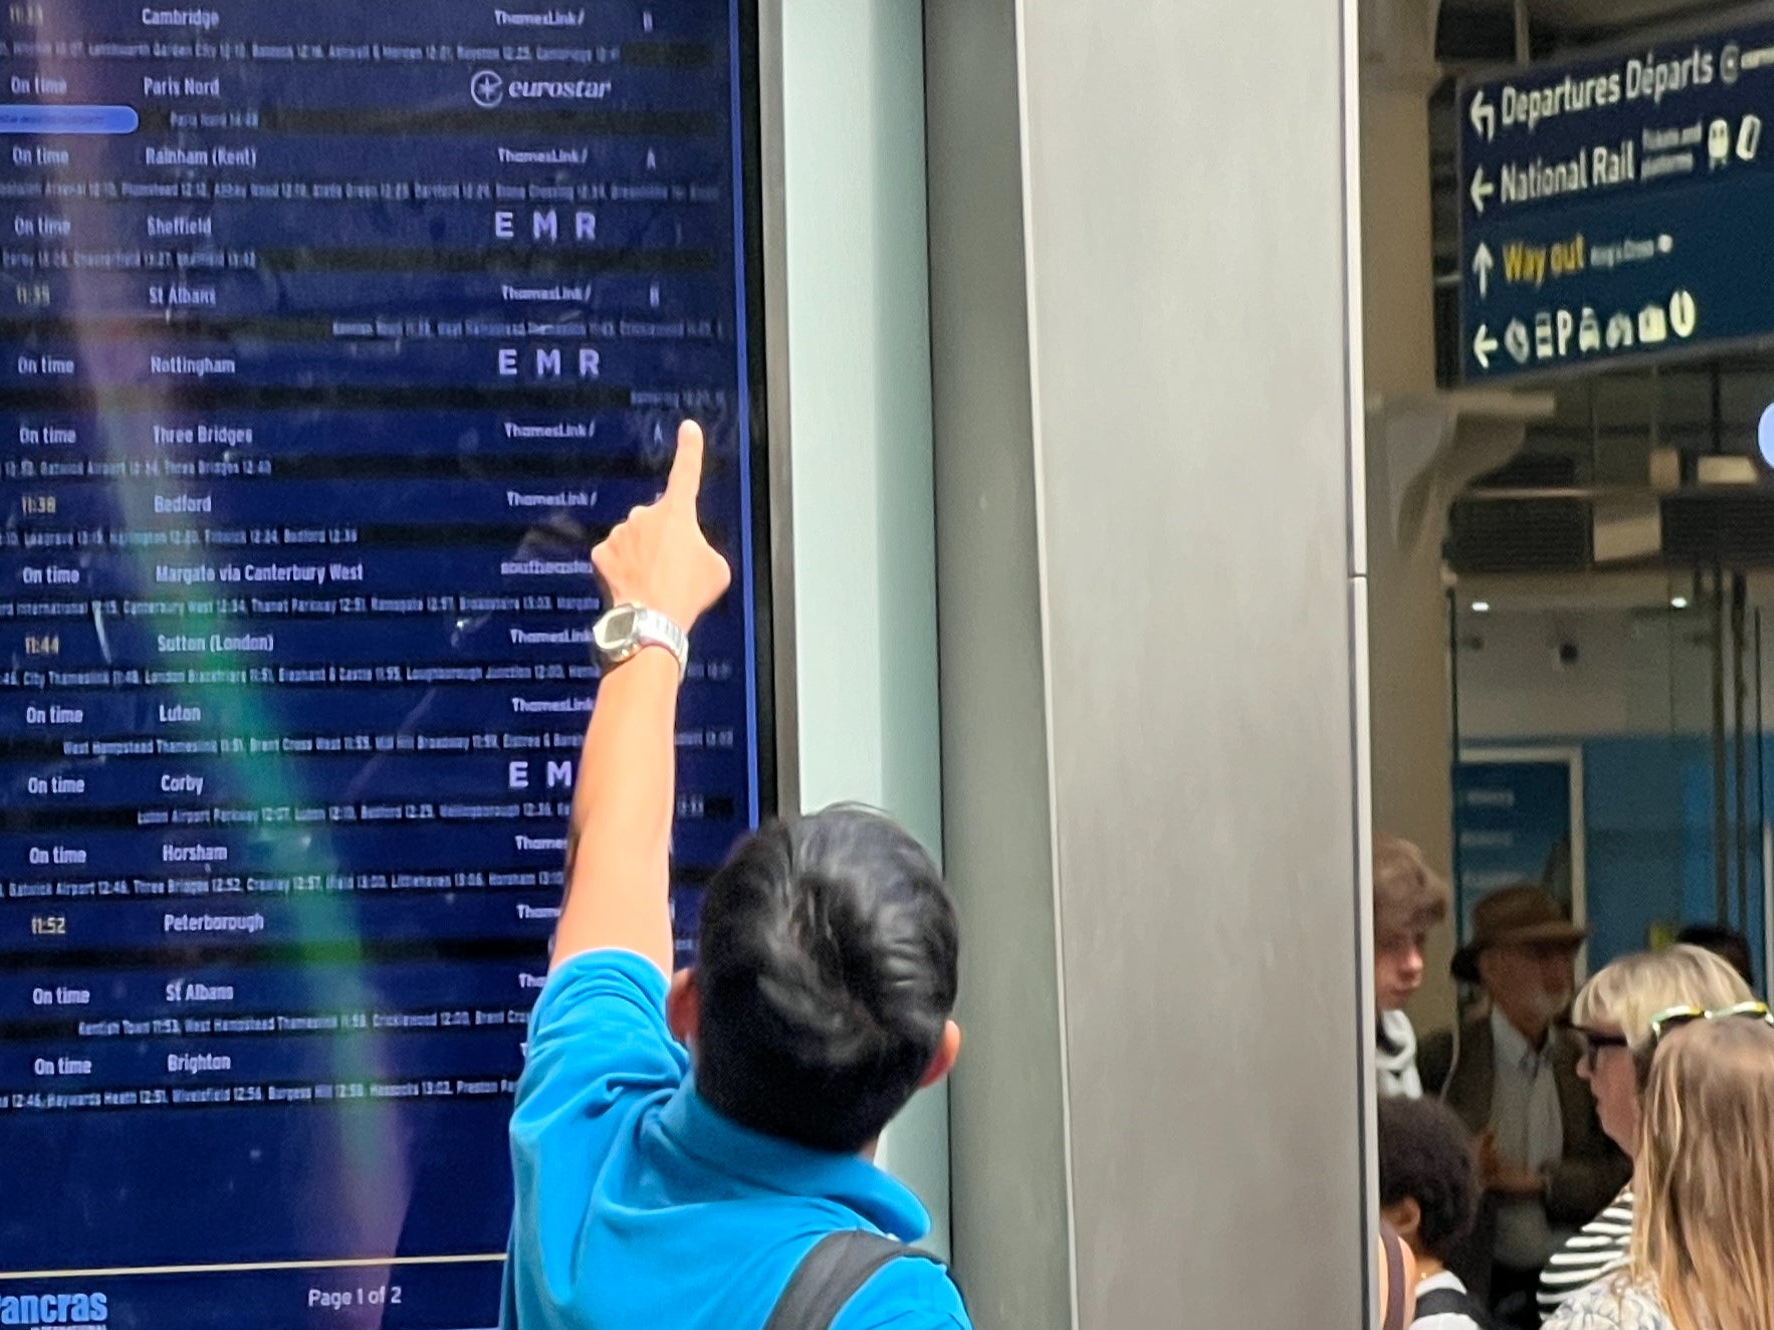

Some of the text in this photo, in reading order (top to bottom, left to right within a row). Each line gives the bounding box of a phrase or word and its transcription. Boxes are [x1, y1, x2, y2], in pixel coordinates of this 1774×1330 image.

[142, 8, 219, 29] Cambridge
[11, 76, 67, 94] On time
[144, 77, 219, 95] Paris Nord
[509, 79, 611, 98] eurostar
[1501, 73, 1620, 132] Departures
[13, 146, 69, 164] On time
[146, 147, 256, 166] Rainham (Kent)
[1501, 147, 1588, 204] National
[1592, 139, 1636, 187] Rail
[14, 216, 71, 236] On time
[147, 216, 211, 236] Sheffield
[1550, 233, 1585, 278] out
[149, 286, 216, 304] St Albans
[18, 356, 74, 374] On time
[151, 356, 235, 377] Nottingham
[20, 427, 76, 445] On time
[154, 425, 252, 446] Three Bridges
[155, 495, 212, 513] Bedford
[23, 565, 79, 584] On time
[156, 563, 364, 586] Margate via Canterbury West
[25, 636, 59, 655] 11:44
[158, 635, 273, 653] Sutton (London)
[26, 705, 83, 724] On time
[159, 705, 201, 722] Luton
[510, 761, 573, 788] EM
[28, 776, 85, 794] On time
[161, 775, 204, 795] Corby
[29, 845, 86, 864] On time
[162, 845, 227, 862] Horsham
[32, 917, 66, 935] 11:52
[164, 914, 263, 933] Peterborough
[33, 987, 89, 1005] On time
[166, 984, 233, 1001] St Albans
[35, 1057, 92, 1075] On time
[167, 1054, 231, 1074] Brighton
[308, 1286, 402, 1311] Page 1 of 2
